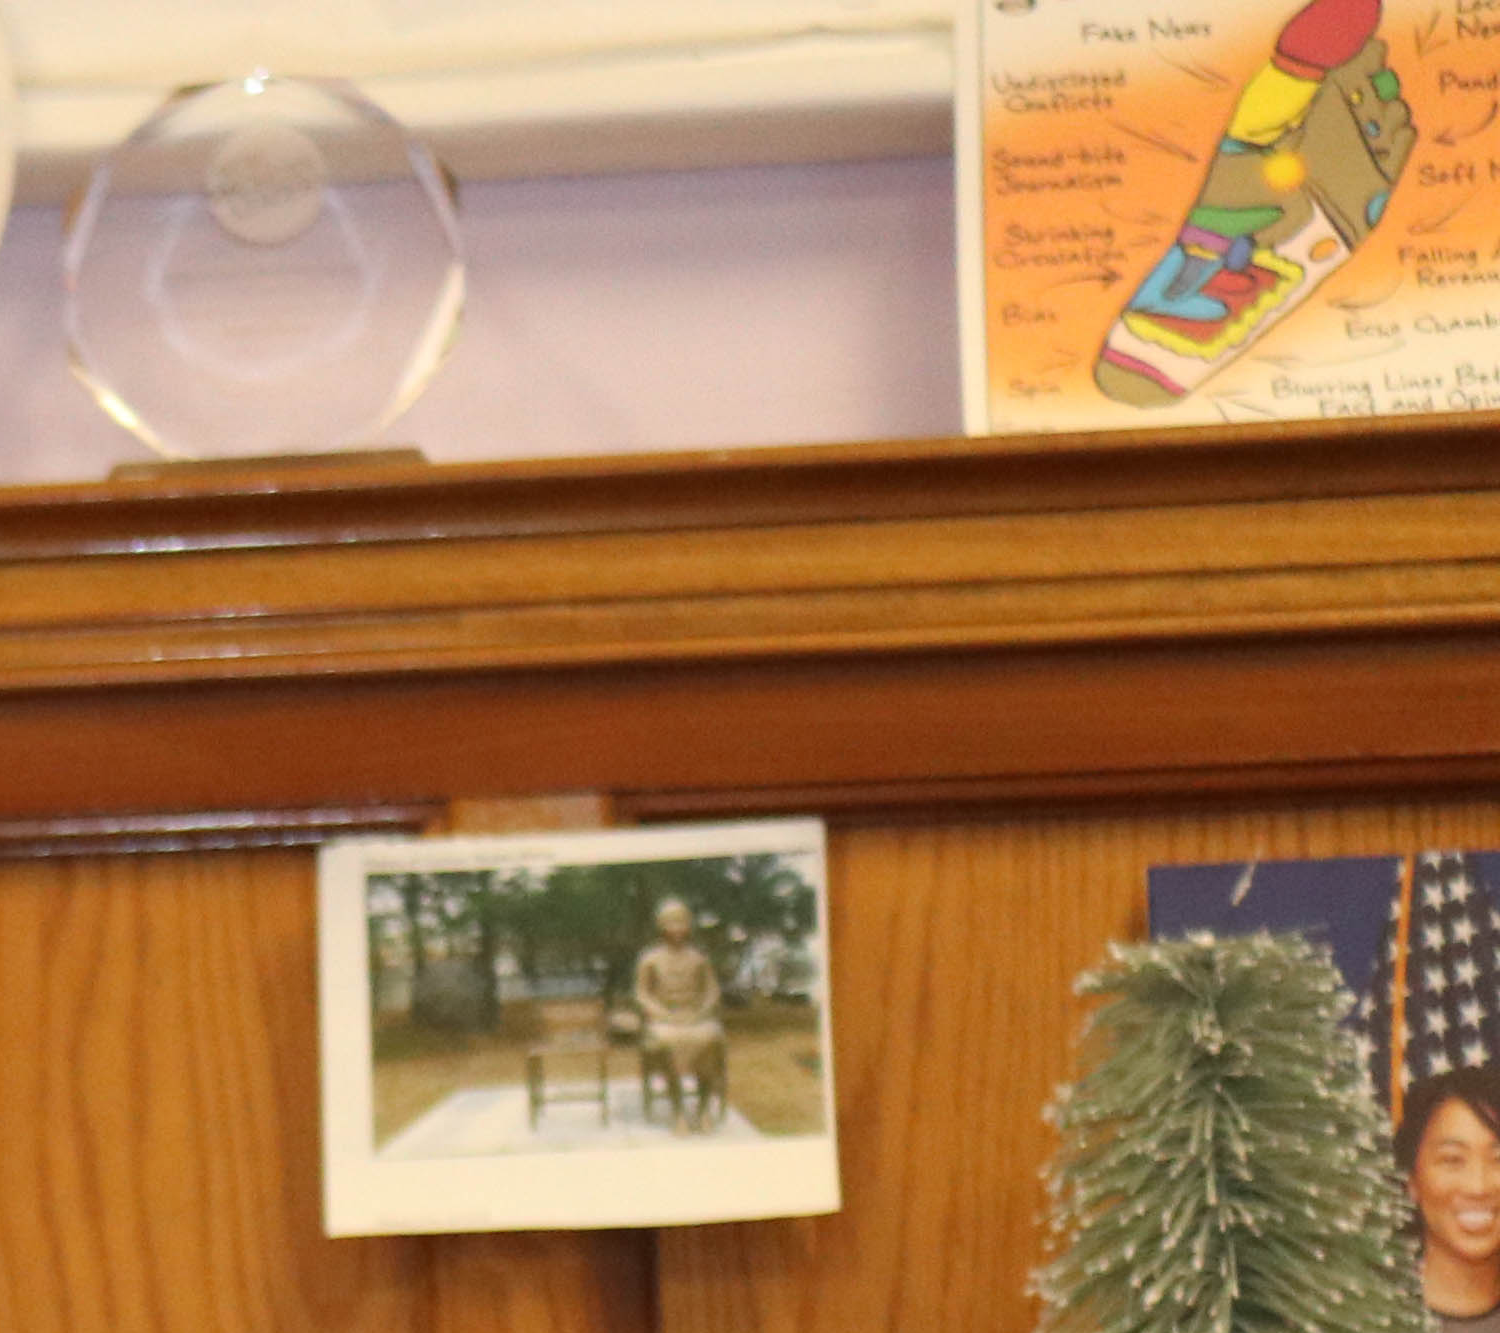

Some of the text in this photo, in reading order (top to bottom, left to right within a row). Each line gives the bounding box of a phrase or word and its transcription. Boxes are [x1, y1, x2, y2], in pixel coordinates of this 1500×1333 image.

[1081, 17, 1211, 44] Fake News
[1419, 160, 1476, 188] Soft
